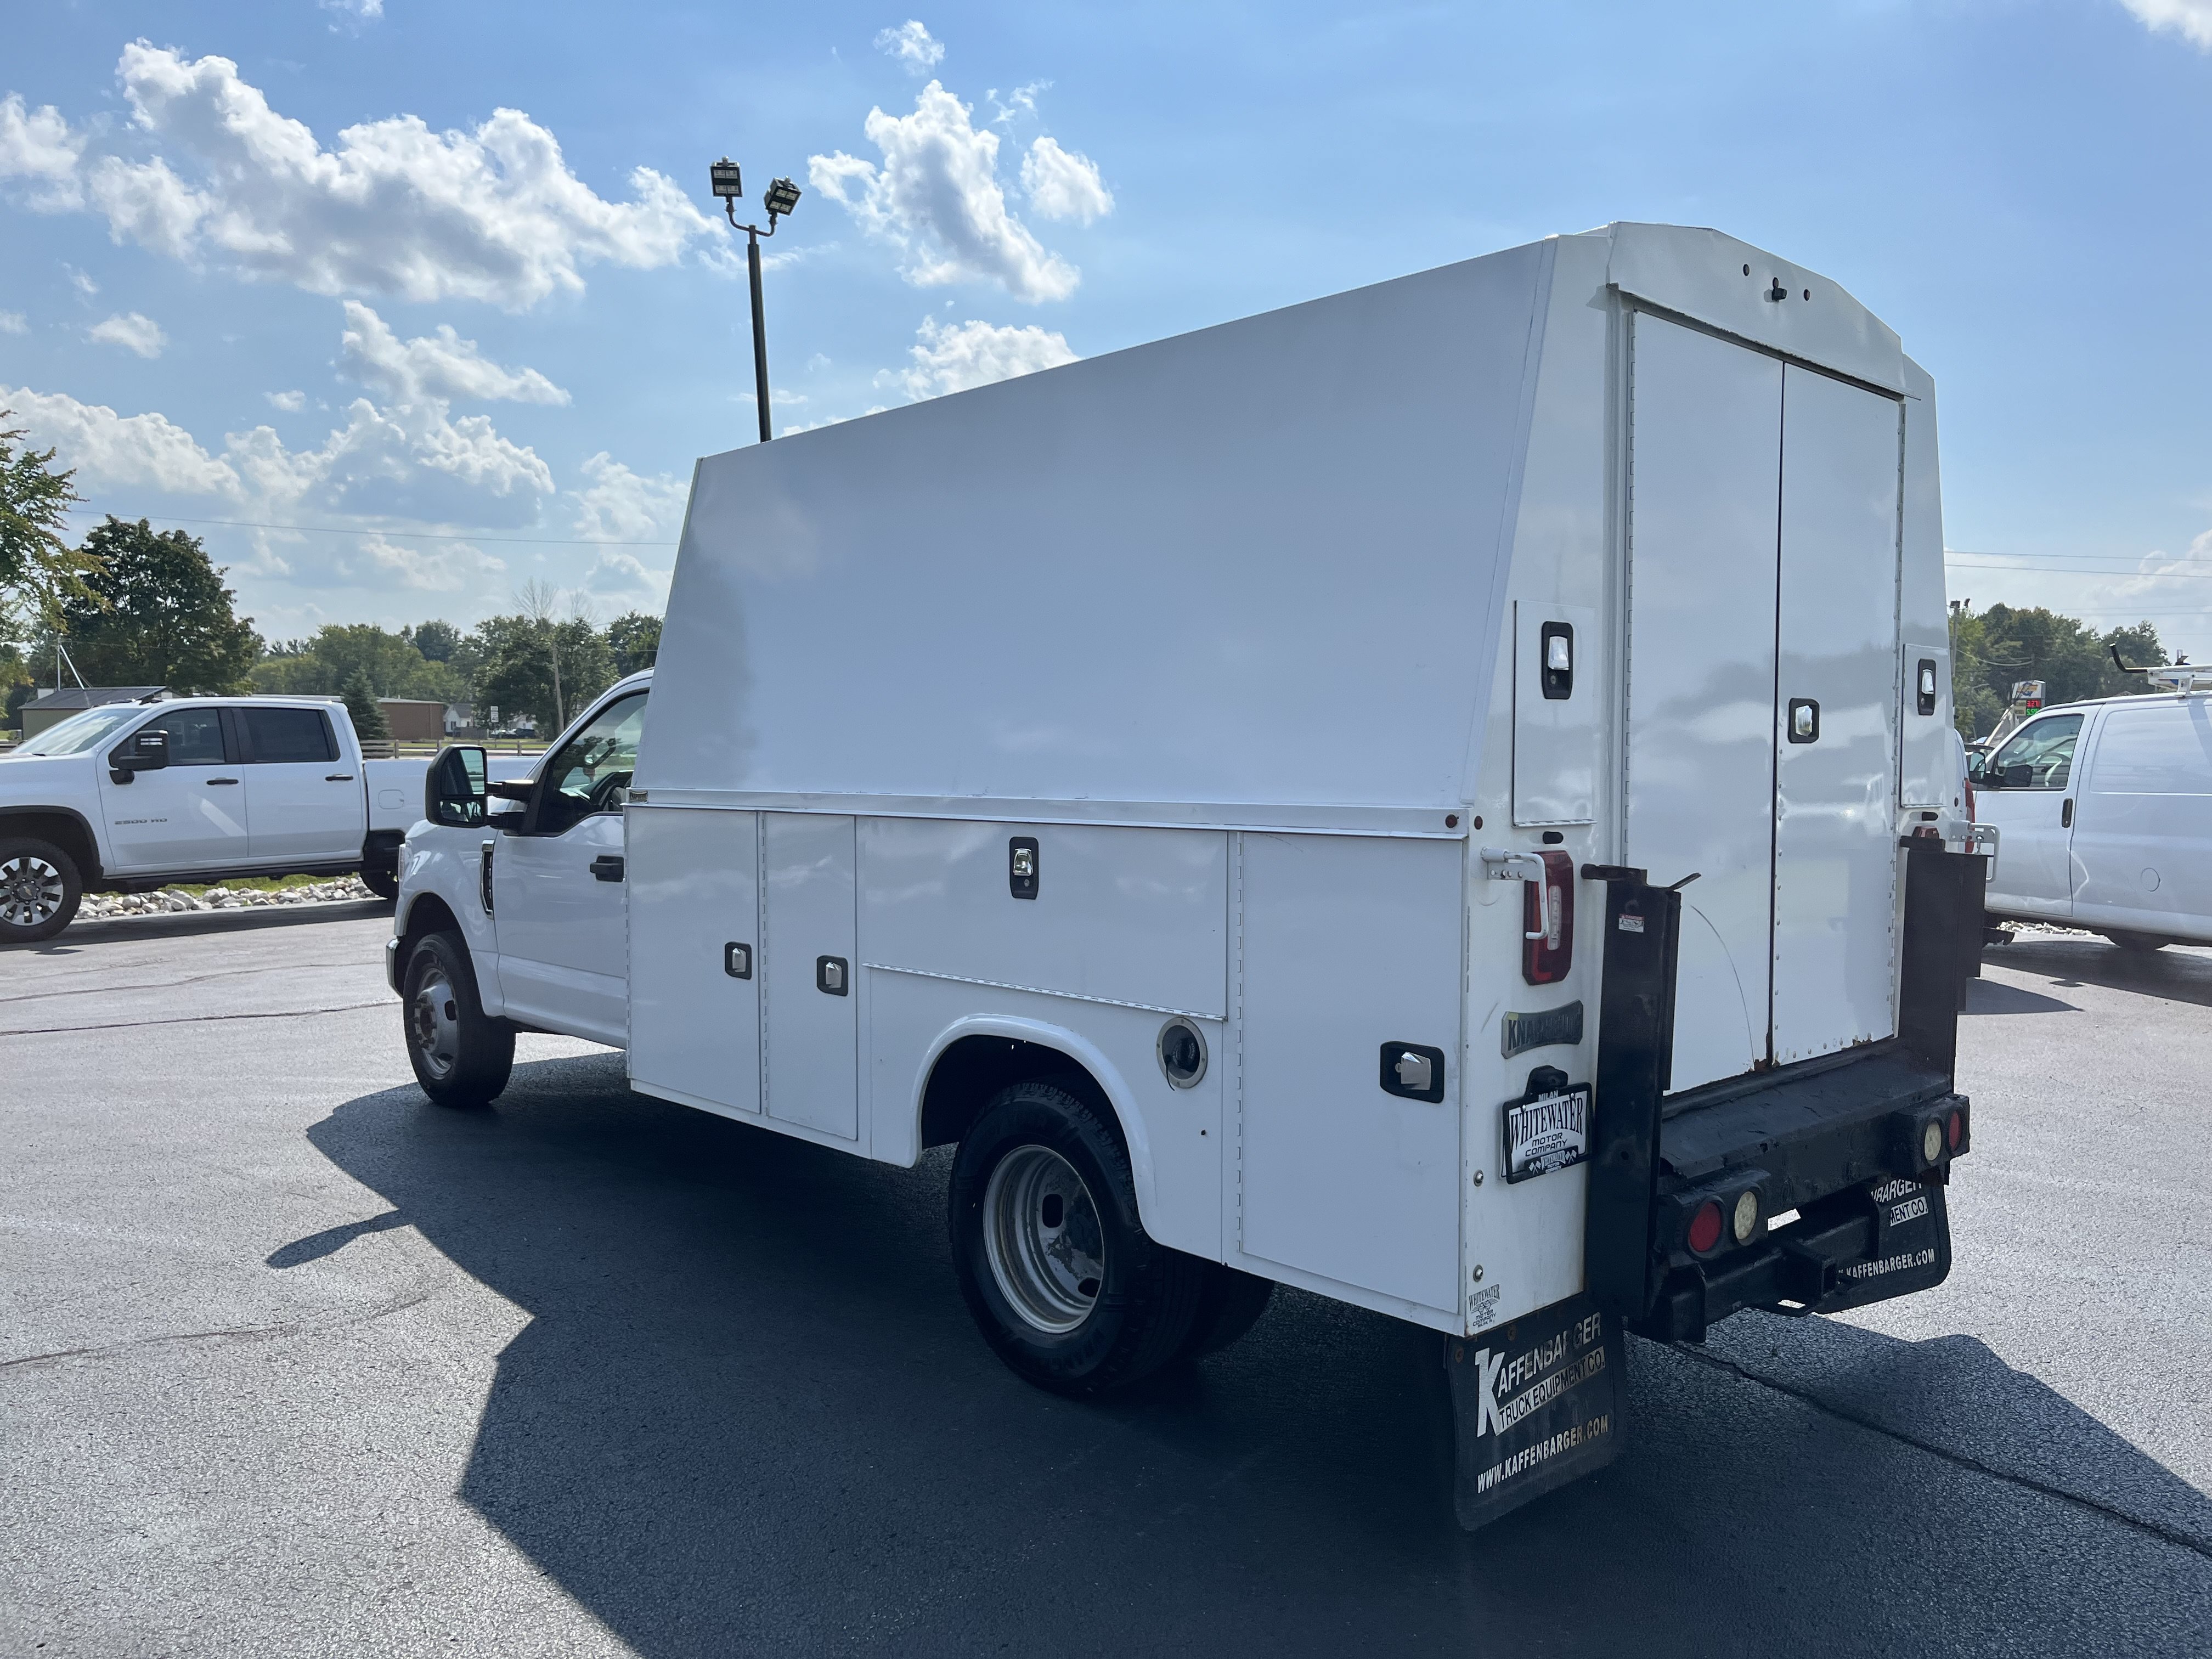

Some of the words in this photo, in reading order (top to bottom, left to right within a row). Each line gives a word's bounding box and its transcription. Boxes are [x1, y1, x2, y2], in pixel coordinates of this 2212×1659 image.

[1538, 1090, 1559, 1102] MILAN
[1510, 1097, 1583, 1150] WHITEWATER
[1525, 1139, 1568, 1157] COMPANY
[1532, 1132, 1563, 1147] MOTOR
[1911, 1199, 1927, 1215] CO.
[1469, 1284, 1500, 1312] WHITEWATER
[1472, 1312, 1497, 1327] COMPANY
[1475, 1309, 1493, 1321] MOTOR
[1499, 1392, 1532, 1429] TRUCK
[1533, 1358, 1585, 1407] EQUIPMENT
[1588, 1350, 1605, 1372] CO.
[1477, 1414, 1608, 1494] WWW.KAFFENBARGER.COM
